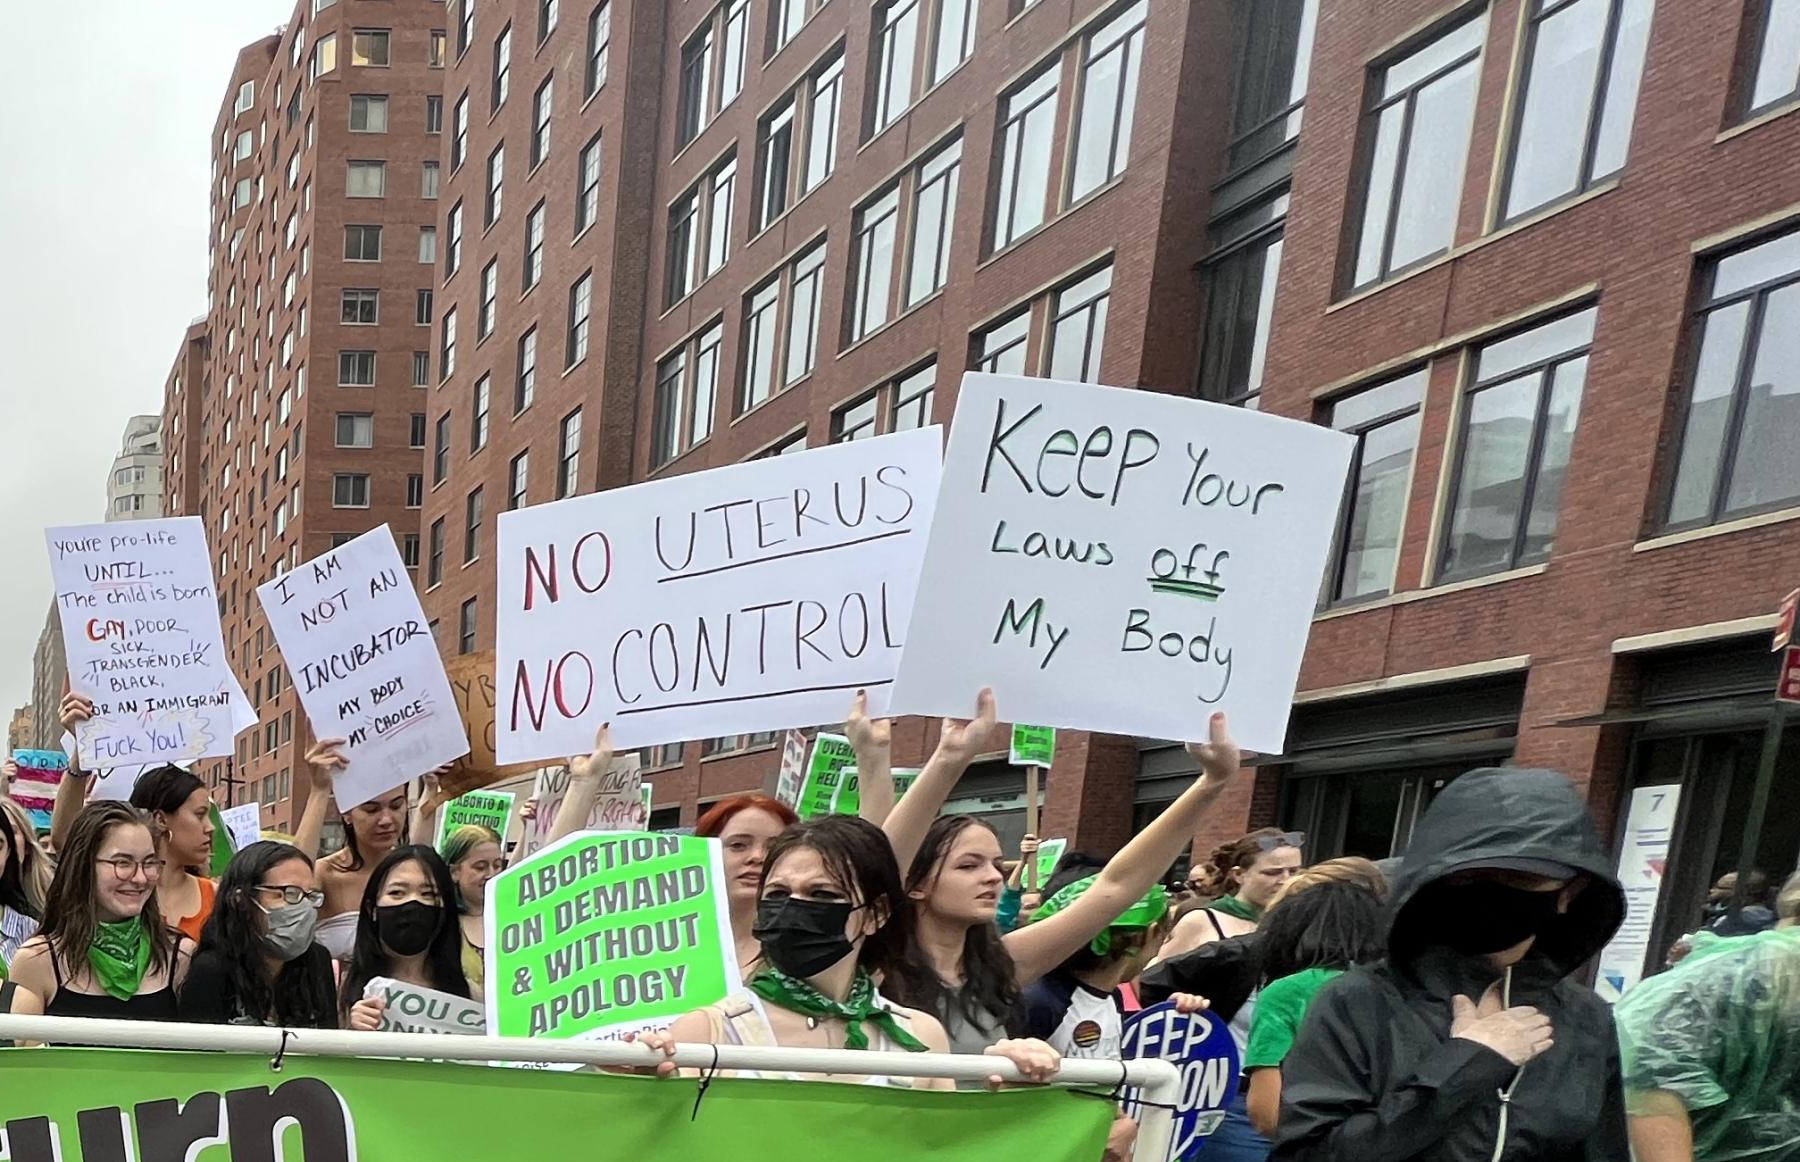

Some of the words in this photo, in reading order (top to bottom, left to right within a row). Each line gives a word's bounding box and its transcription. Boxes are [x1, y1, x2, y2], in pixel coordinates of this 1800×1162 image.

[110, 531, 177, 553] pro-life
[523, 531, 612, 612] NO
[655, 465, 914, 572] UTERUS
[59, 590, 97, 609] The
[107, 585, 147, 605] child
[151, 586, 167, 601] is
[172, 584, 211, 601] born
[274, 576, 296, 605] I
[312, 554, 342, 585] AM
[300, 588, 349, 631] NOT
[370, 568, 398, 599] AN
[298, 620, 429, 694] INCUBATOR
[510, 650, 594, 732] NO
[611, 581, 903, 705] CONTROL
[992, 598, 1070, 670] My
[1121, 608, 1233, 703] Body
[92, 702, 112, 717] OR
[117, 700, 138, 713] AN
[144, 692, 230, 714] IMMIGRANT
[110, 676, 165, 692] BLACK,
[339, 697, 361, 720] MY
[370, 676, 405, 702] BODY
[348, 727, 368, 748] MY
[374, 699, 426, 735] CHOICE
[496, 799, 505, 812] A
[1651, 793, 1665, 813] 7
[517, 835, 681, 908] ABORTION
[501, 914, 543, 955] ON
[553, 865, 706, 937] DEMAND
[511, 966, 532, 997] &
[544, 912, 700, 985] WITHOUT
[384, 987, 451, 1021] YOU
[528, 964, 687, 1038] APOLOGY
